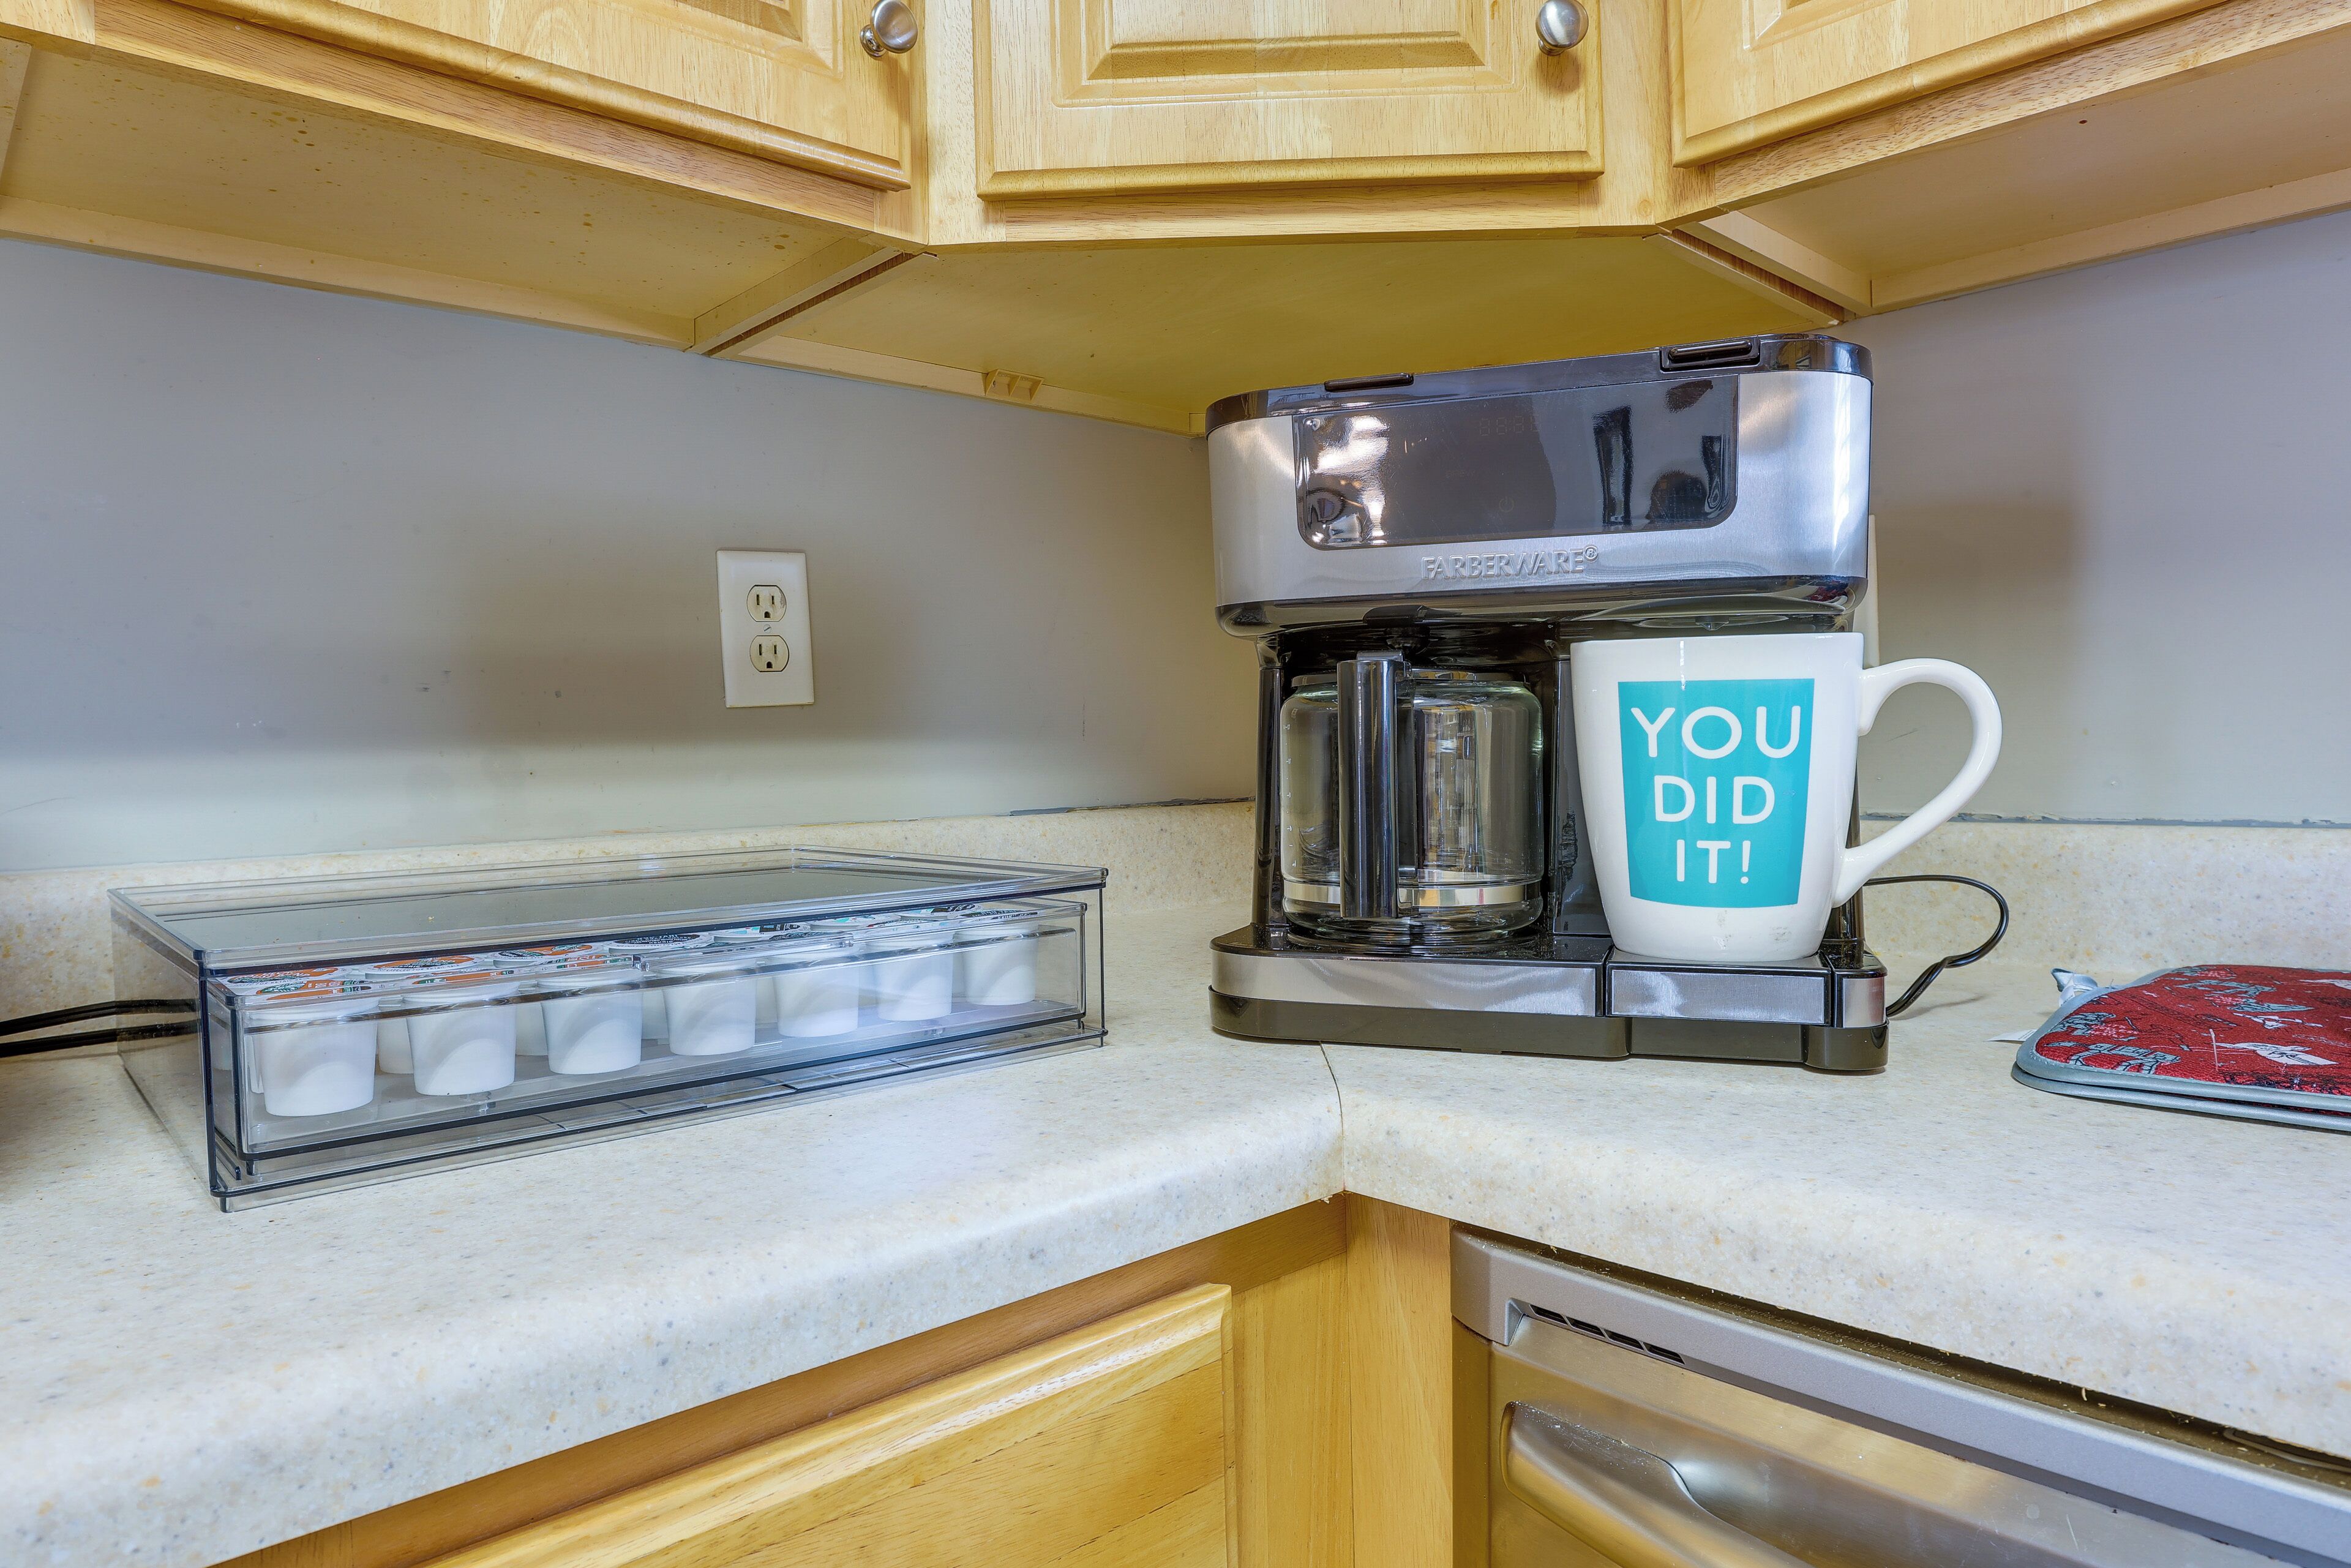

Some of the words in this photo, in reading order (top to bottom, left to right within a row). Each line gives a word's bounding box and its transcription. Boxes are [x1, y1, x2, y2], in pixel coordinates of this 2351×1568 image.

[1630, 705, 1801, 759] YOU
[1654, 775, 1775, 824] DID
[1676, 839, 1751, 884] IT!
[1881, 1344, 1948, 1367] technology
